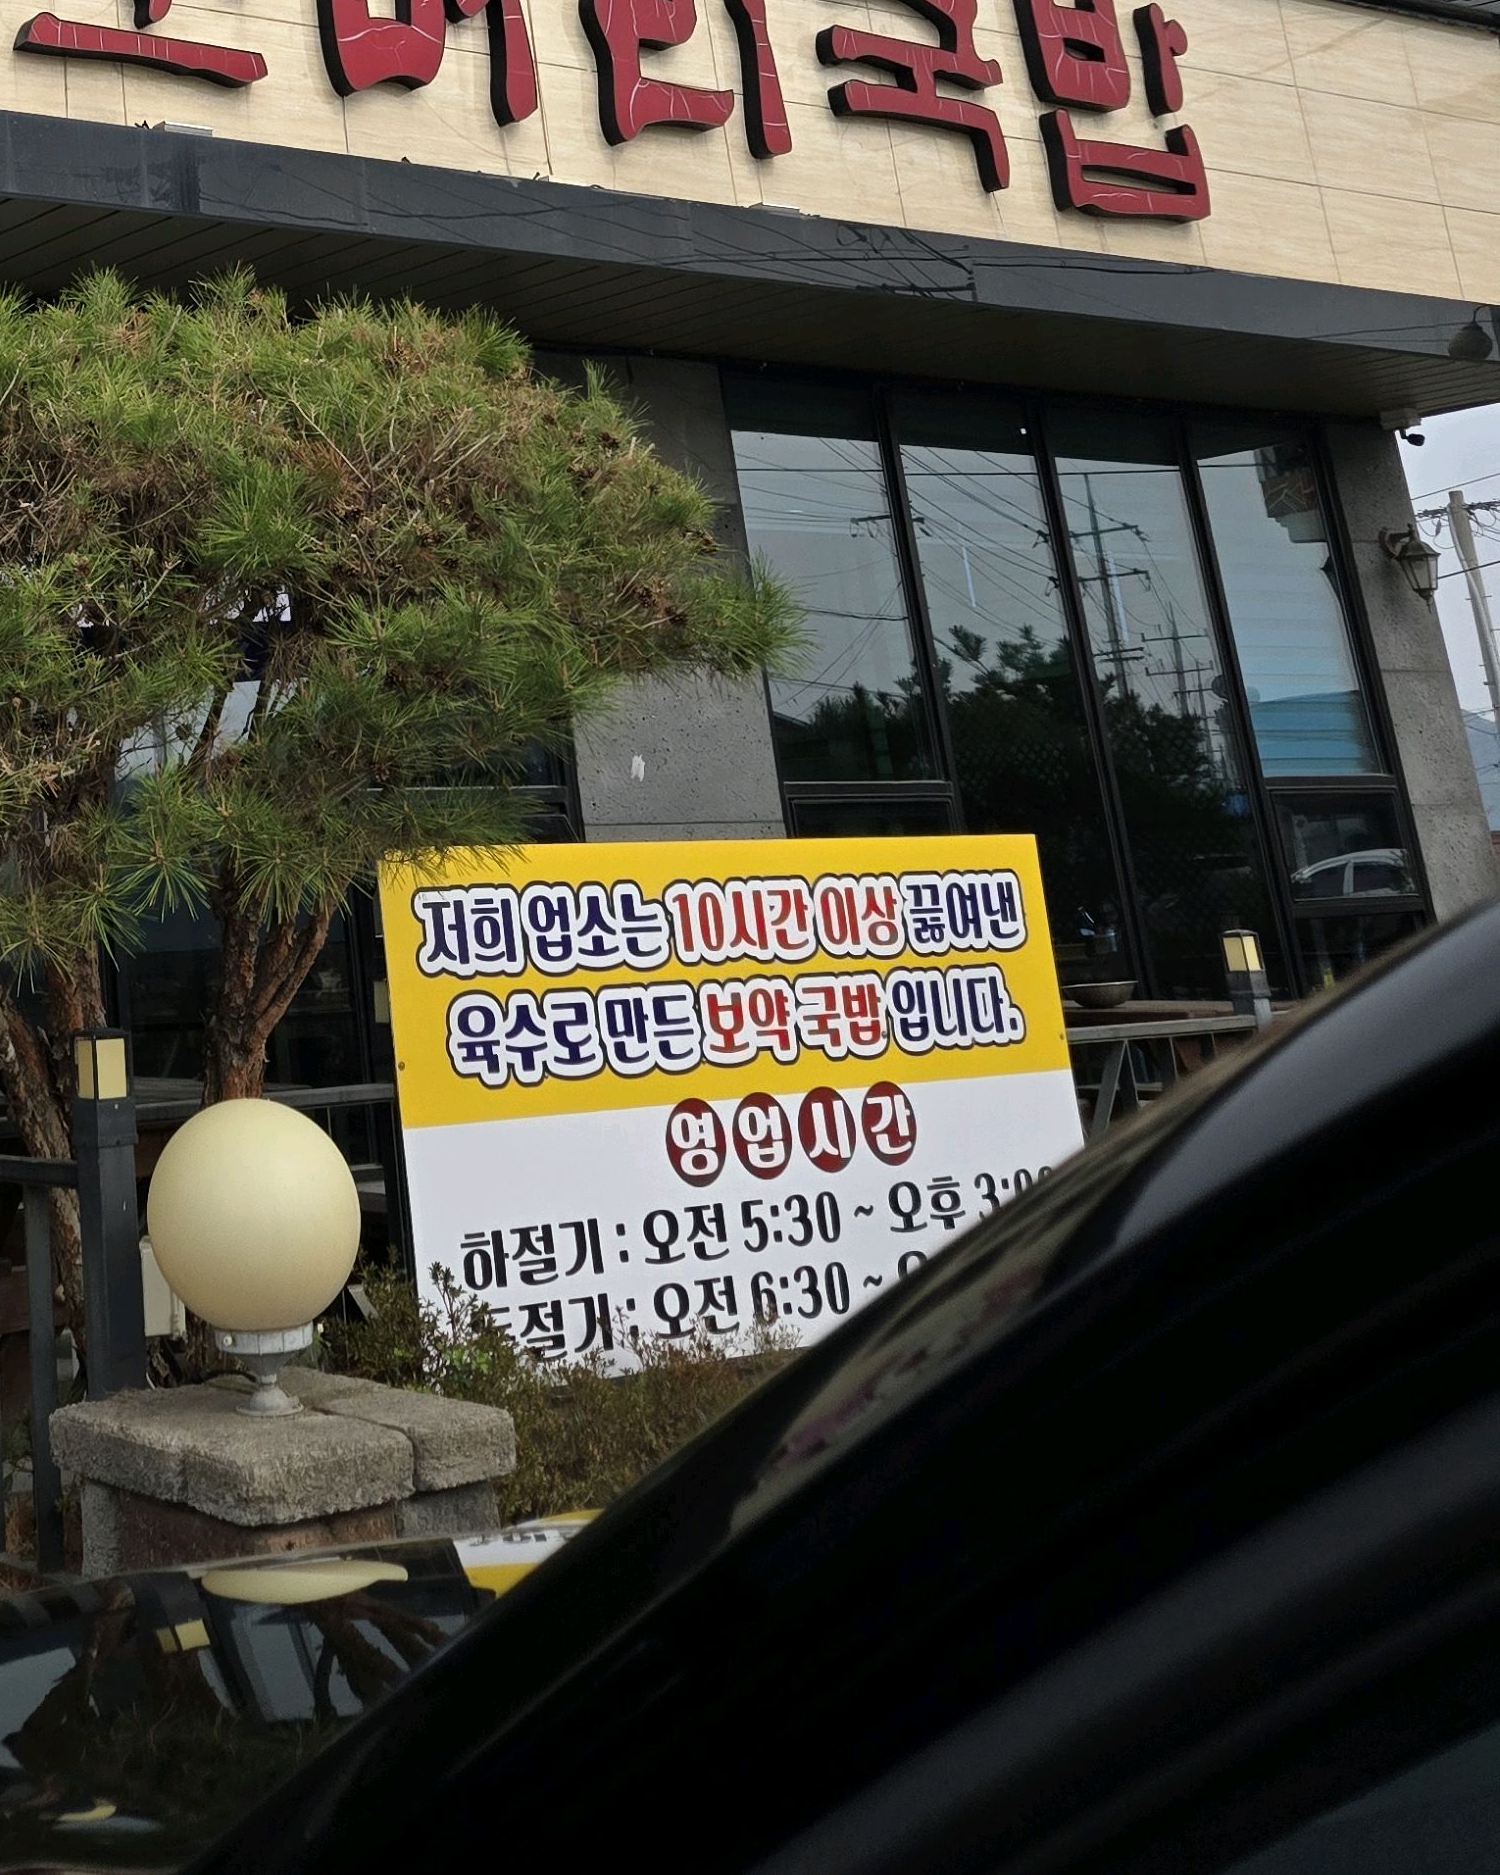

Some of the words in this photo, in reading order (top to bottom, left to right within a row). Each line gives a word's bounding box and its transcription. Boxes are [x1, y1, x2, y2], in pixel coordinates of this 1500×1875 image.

[421, 896, 519, 966] 저희
[526, 892, 663, 963] 업소는
[671, 887, 811, 954] 10시간
[818, 884, 899, 948] 이상
[904, 879, 1022, 946] 끓여낸
[456, 1002, 598, 1074] 육수로
[603, 993, 696, 1065] 만든
[890, 973, 1019, 1043] 입니다.
[668, 1092, 913, 1177] 영업시간
[642, 1201, 731, 1266] 오전
[740, 1190, 842, 1253] 5:30
[887, 1175, 967, 1234] 오후
[973, 1165, 1054, 1221] 3:
[488, 1292, 614, 1362] 절기
[652, 1274, 742, 1341] 오전
[750, 1261, 851, 1325] 6:30
